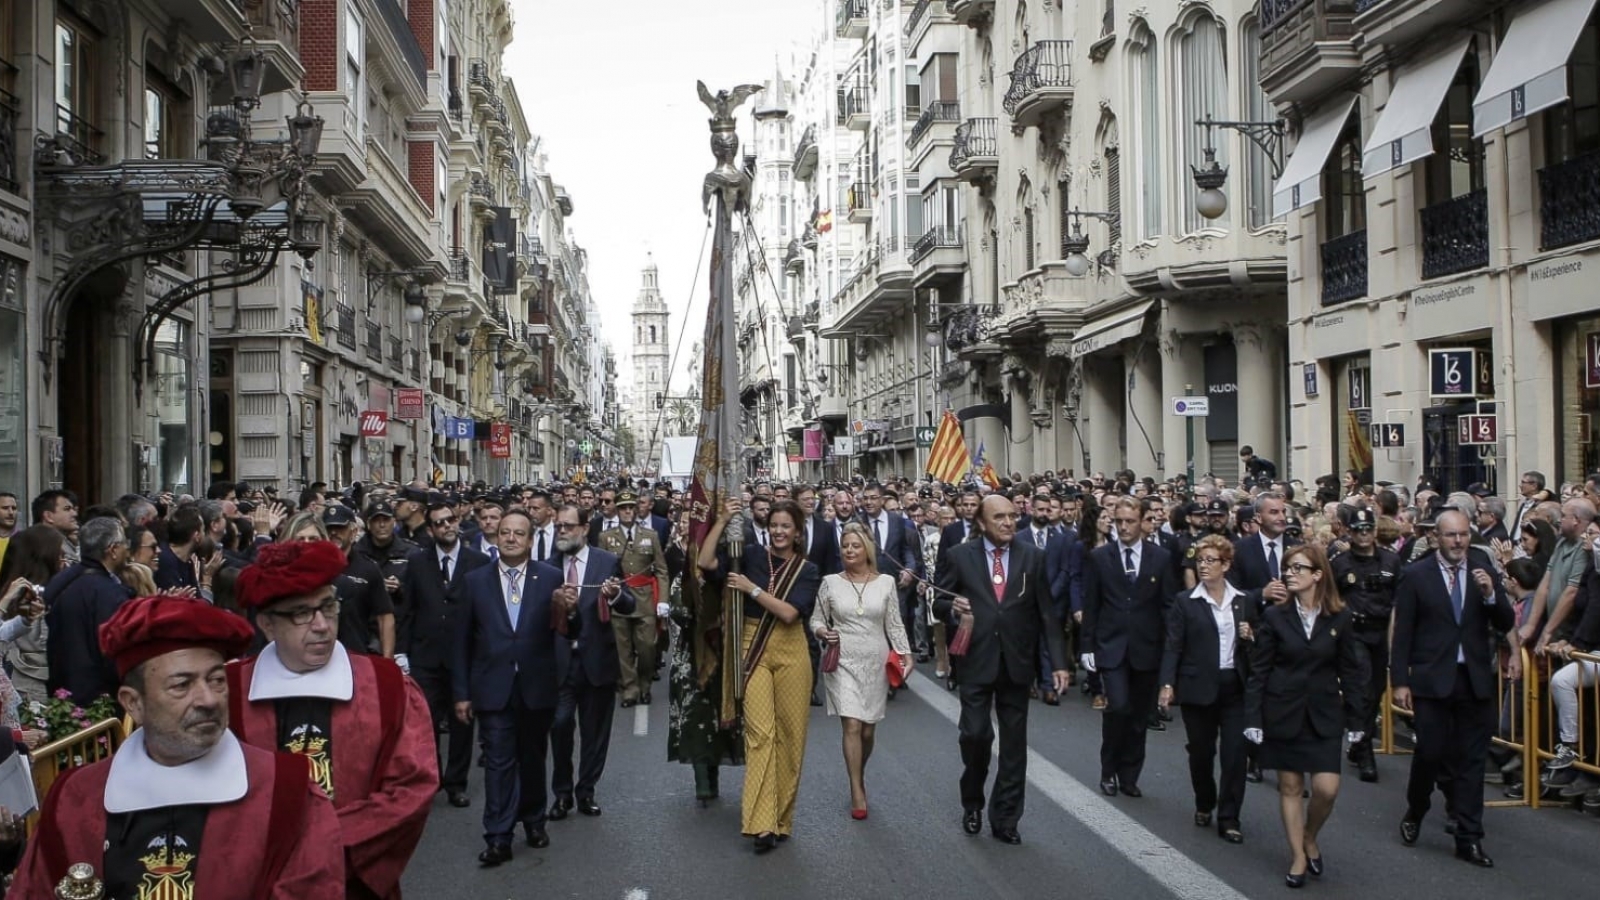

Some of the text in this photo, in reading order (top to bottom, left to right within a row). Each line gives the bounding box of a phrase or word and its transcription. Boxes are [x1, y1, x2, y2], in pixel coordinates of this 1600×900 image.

[1442, 353, 1461, 384] 16
[362, 415, 385, 435] illy
[1478, 418, 1490, 434] 16
